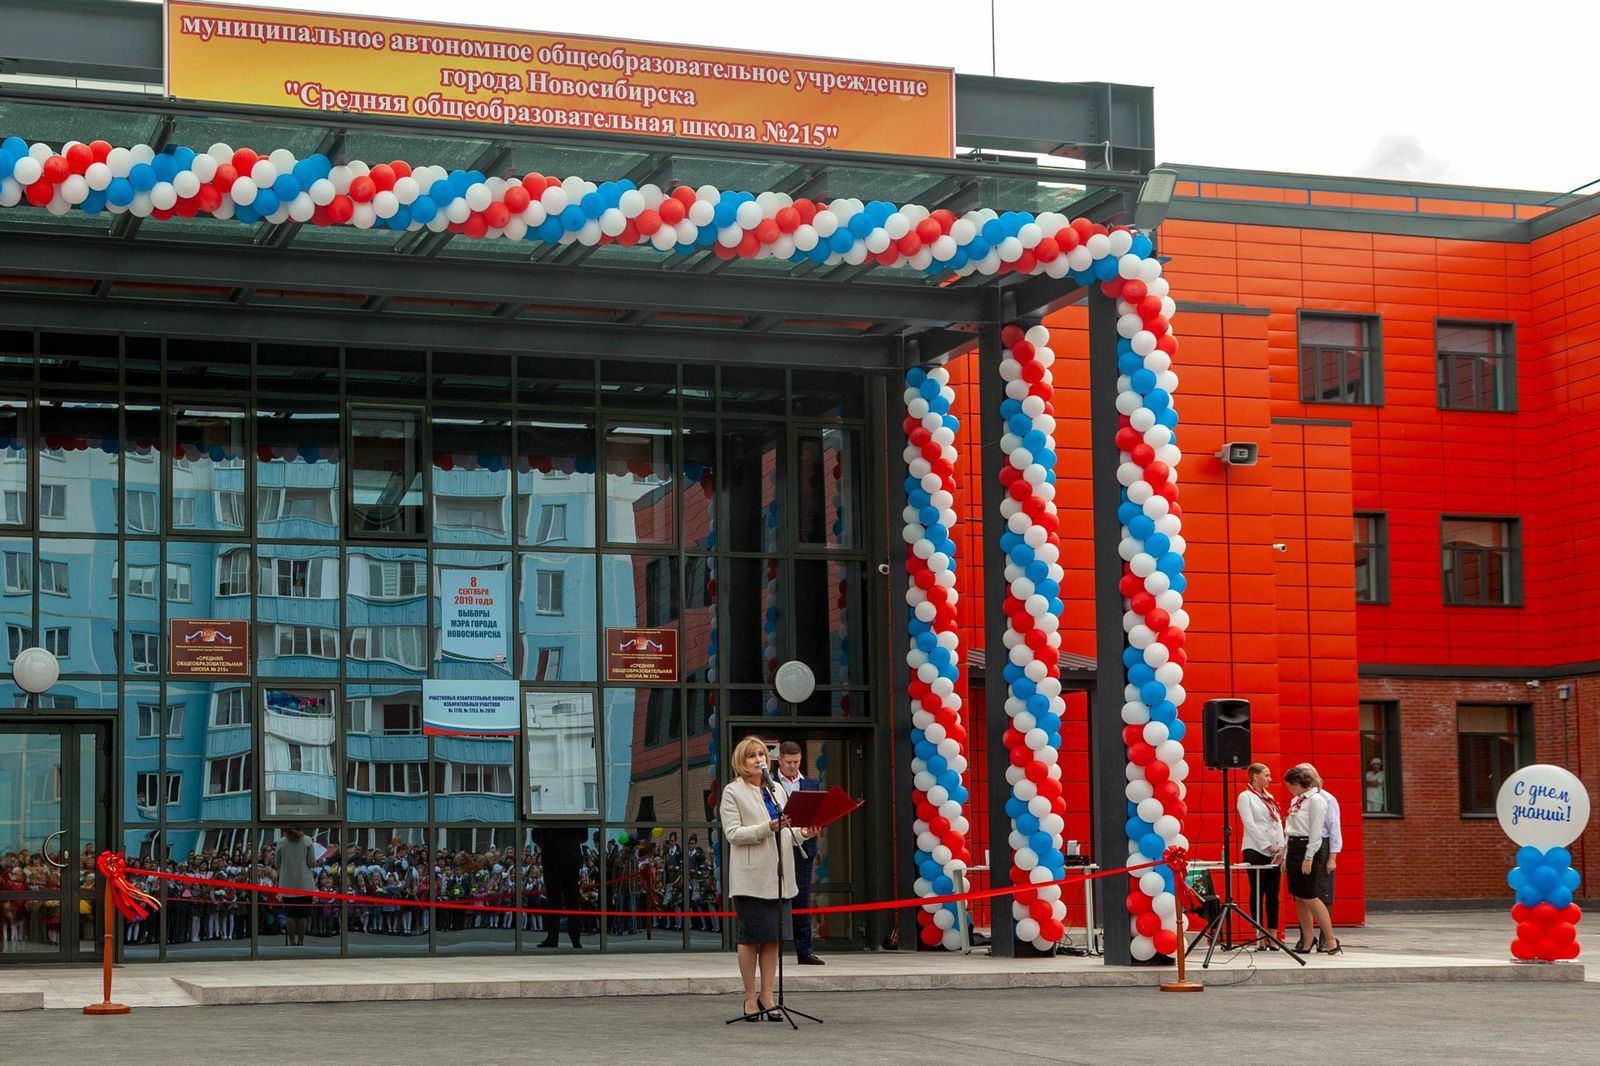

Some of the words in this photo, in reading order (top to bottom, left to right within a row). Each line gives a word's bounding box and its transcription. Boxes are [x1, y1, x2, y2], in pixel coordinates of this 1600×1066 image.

[181, 15, 384, 50] муниципальное
[390, 32, 533, 62] автономное
[538, 43, 790, 84] общеобразовательное
[795, 67, 928, 97] учреждение
[441, 68, 521, 94] города
[526, 71, 696, 107] Новосибирска
[285, 81, 410, 113] "Средняя
[414, 94, 676, 135] общеобразовательная
[680, 118, 757, 142] школа
[761, 120, 839, 146] №215"
[470, 576, 478, 588] 8
[454, 596, 474, 605] 2019
[458, 609, 490, 618] ВЫБОРЫ
[450, 620, 470, 628] МЭРА
[471, 620, 498, 629] ГОРОДА
[447, 630, 502, 639] НОВОСИБИРСКА
[1514, 781, 1525, 796] С
[1528, 785, 1570, 805] днем
[1512, 804, 1571, 825] знаний!
